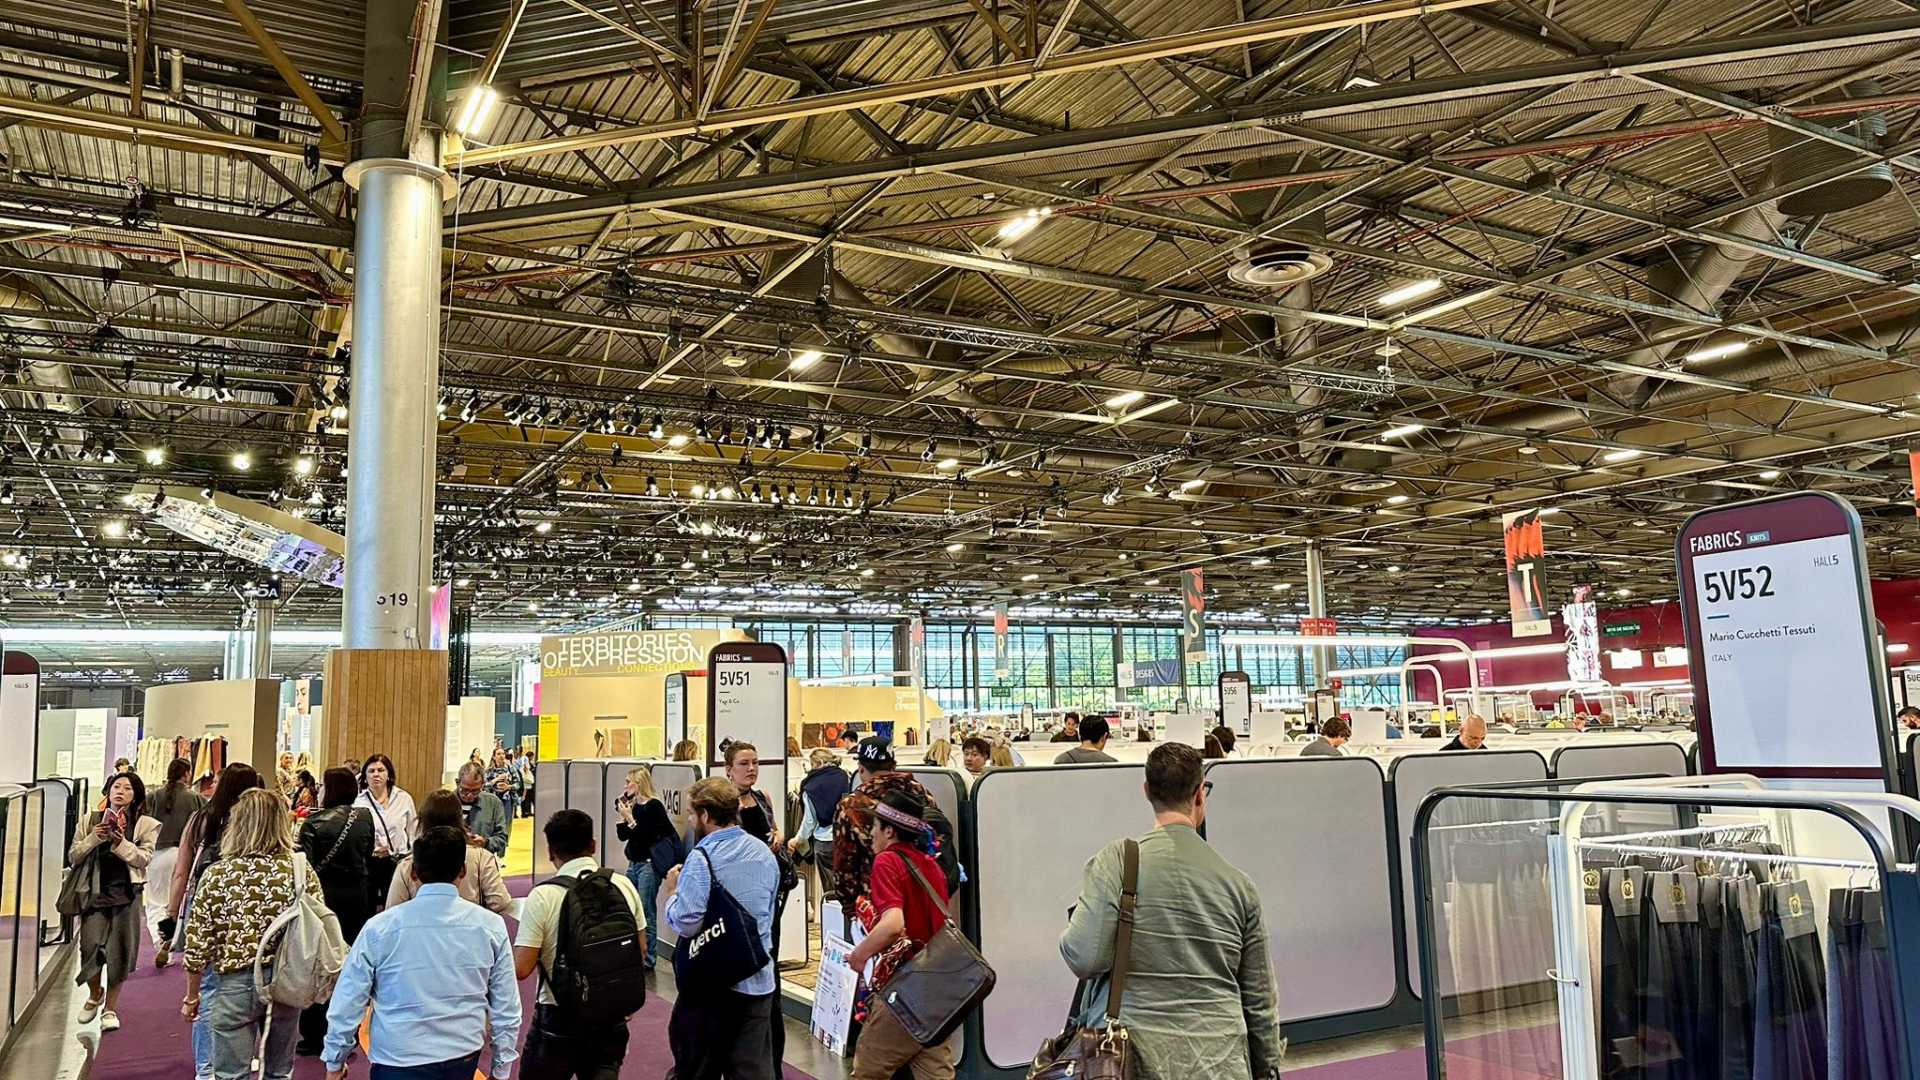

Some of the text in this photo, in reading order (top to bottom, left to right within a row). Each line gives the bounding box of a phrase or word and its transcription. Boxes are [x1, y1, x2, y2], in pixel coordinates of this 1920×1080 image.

[1690, 531, 1742, 552] FABRICS
[1517, 563, 1534, 602] T
[1704, 565, 1775, 603] 5V52
[1189, 608, 1199, 638] S
[1709, 624, 1816, 642] Mario Cucchetti Tessuti
[998, 634, 1005, 658] R
[715, 654, 741, 662] FABRICS
[1712, 654, 1733, 662] ITALY
[543, 667, 578, 678] BEAUTY
[720, 671, 750, 686] 5V51
[864, 744, 878, 760] NY
[662, 788, 682, 815] YAGI
